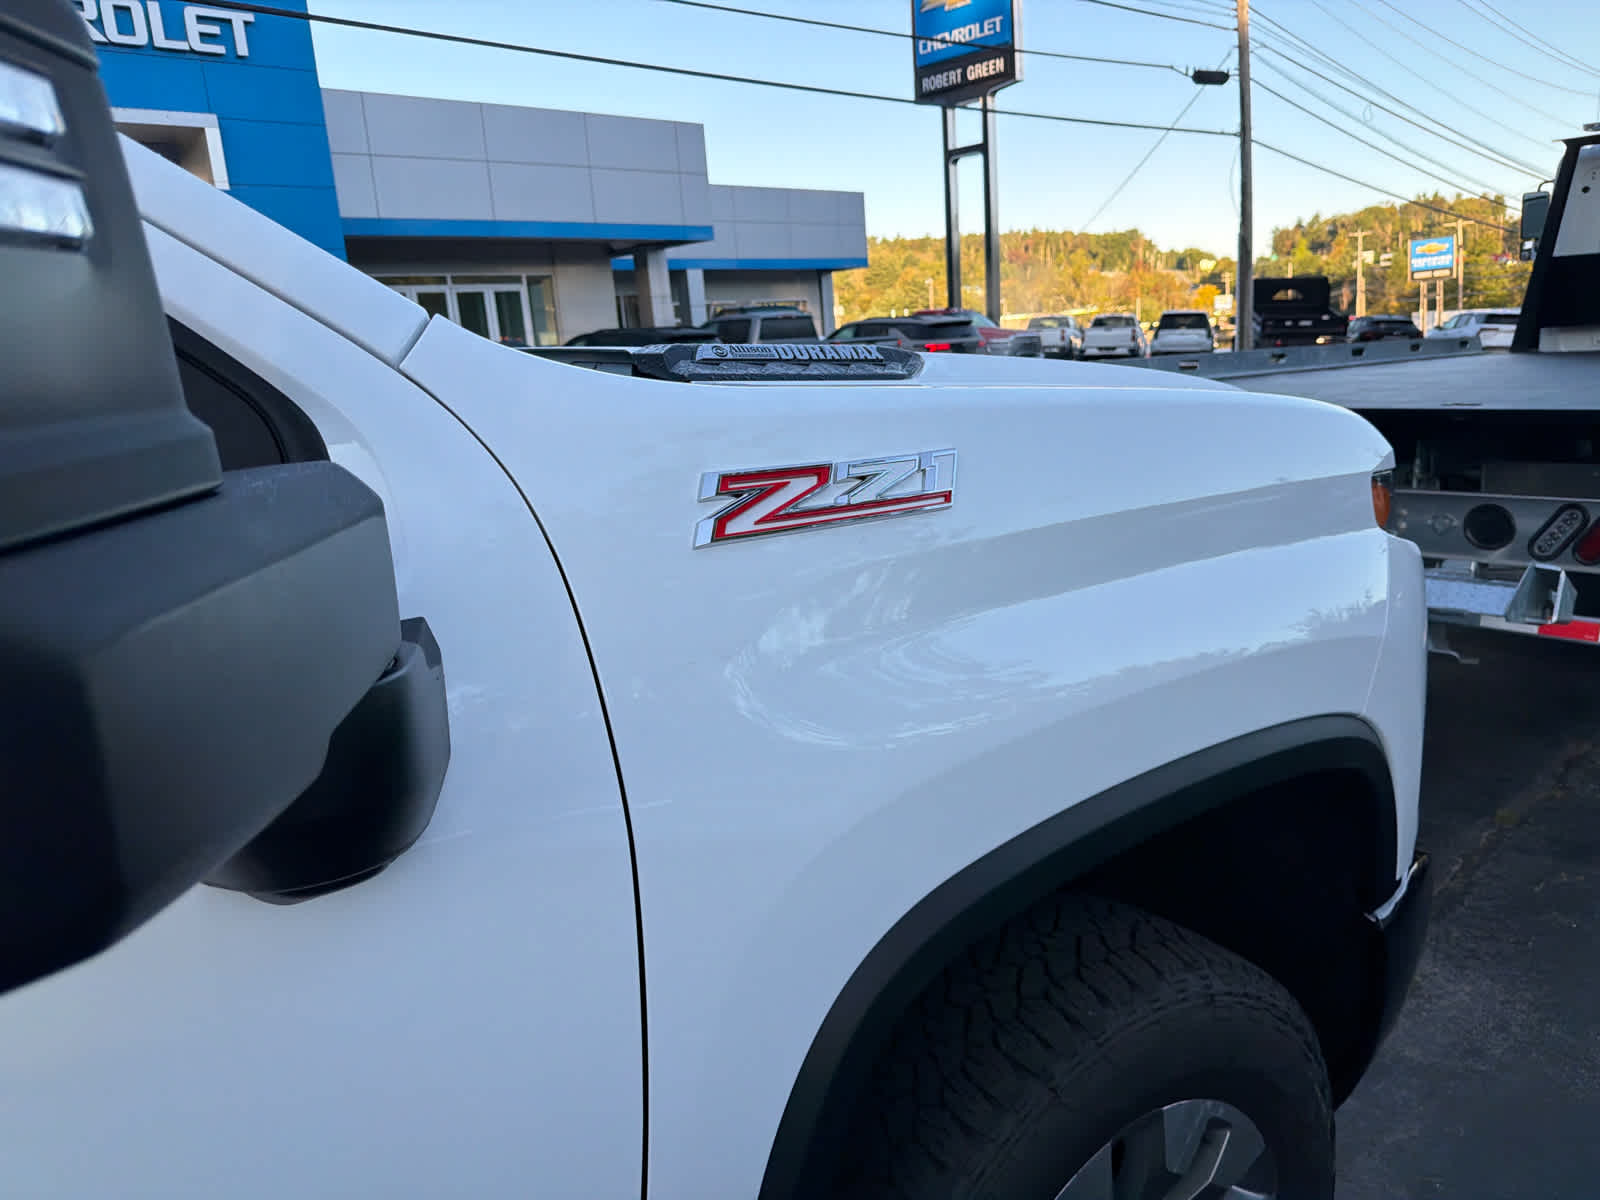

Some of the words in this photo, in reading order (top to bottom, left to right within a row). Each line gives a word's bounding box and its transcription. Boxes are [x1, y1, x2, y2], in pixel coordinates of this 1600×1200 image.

[918, 15, 1003, 55] CHEVROLET
[921, 68, 962, 93] ROBERT
[966, 56, 1004, 81] GREEN
[728, 344, 772, 353] Allison
[774, 344, 884, 360] DURAMAX
[692, 447, 958, 551] Z71
